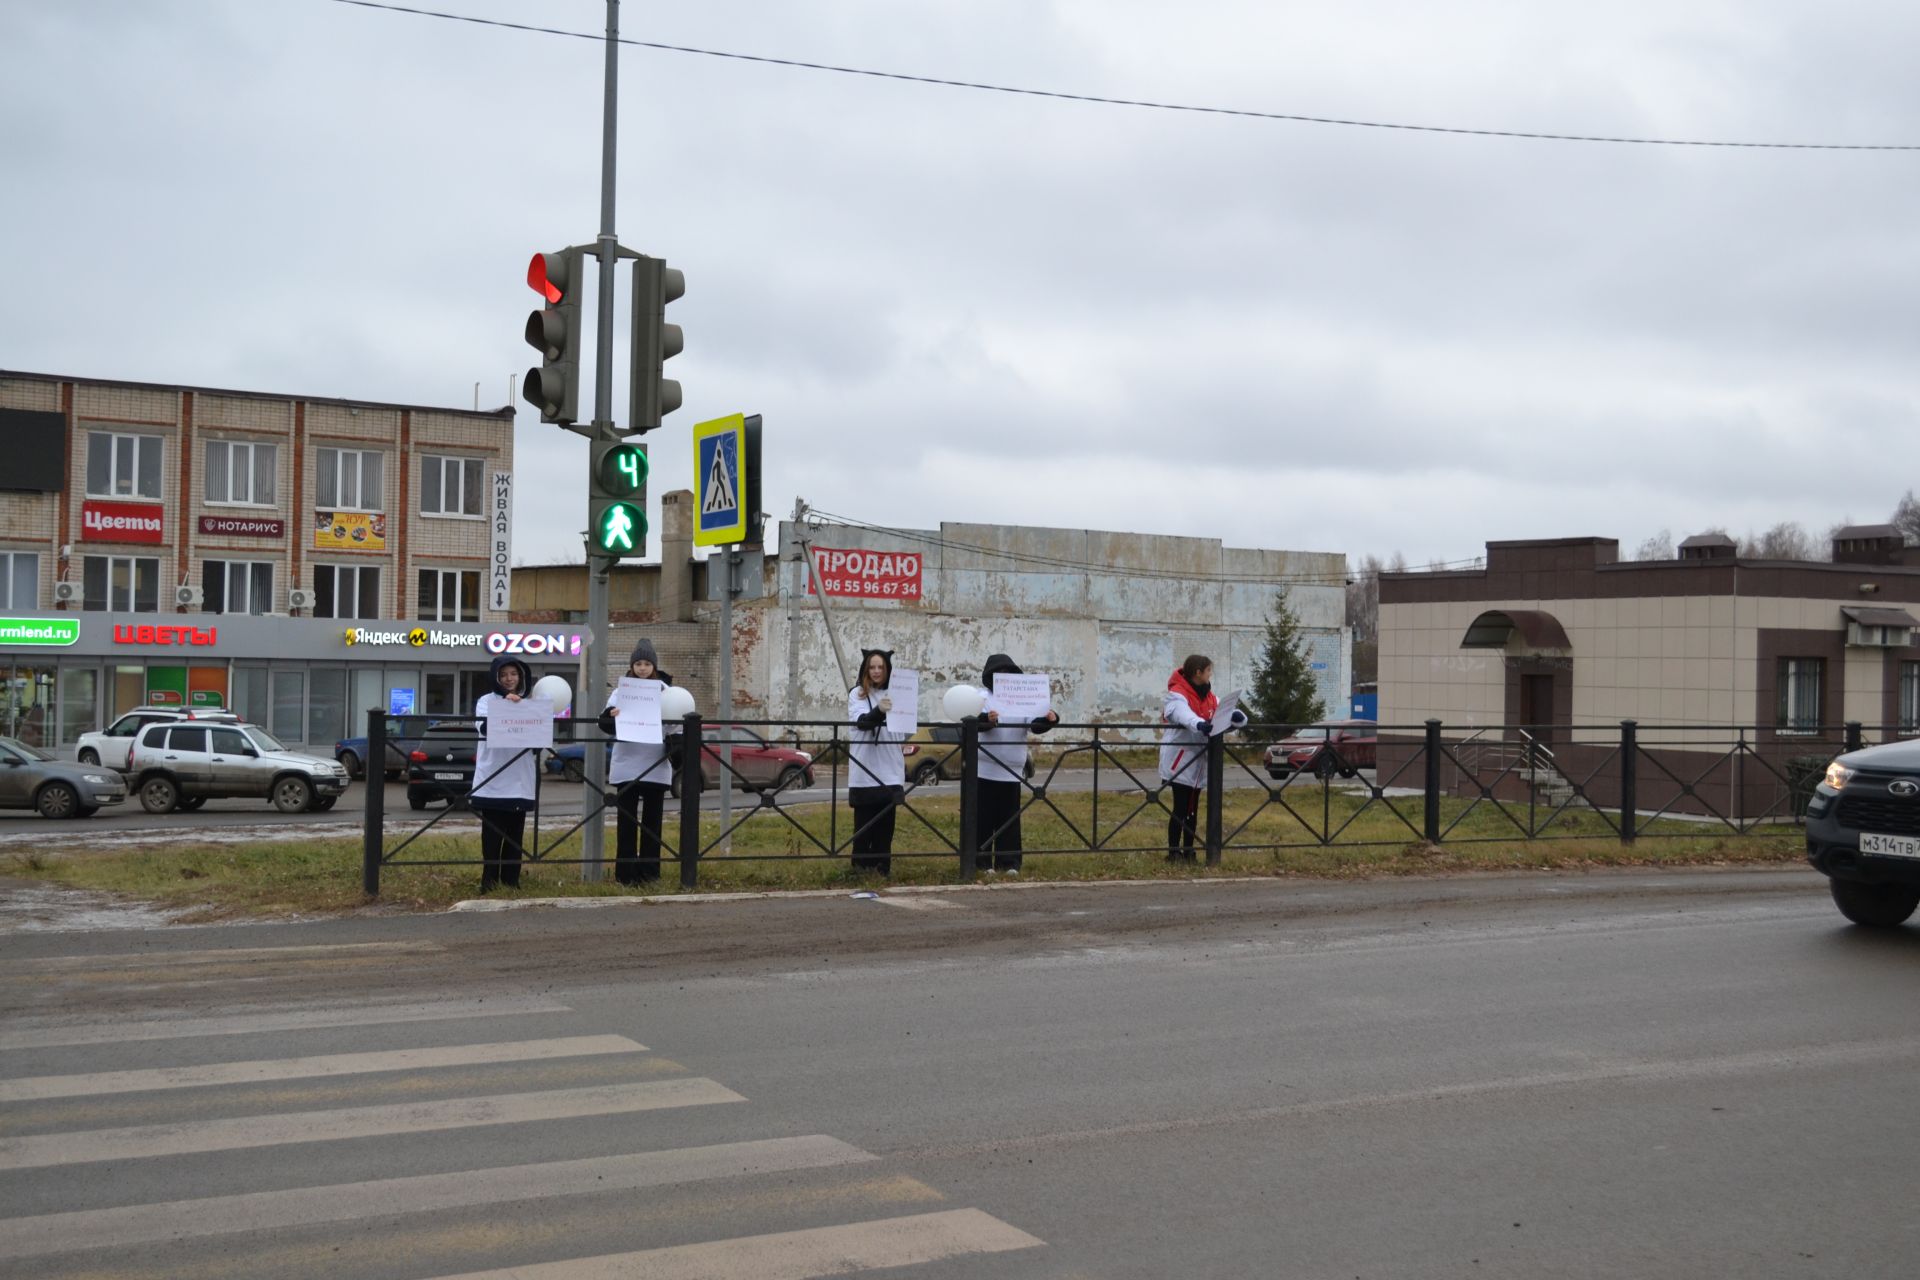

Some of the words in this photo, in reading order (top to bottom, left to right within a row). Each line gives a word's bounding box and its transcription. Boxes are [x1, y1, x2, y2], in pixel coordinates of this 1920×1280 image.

[620, 454, 638, 487] 4
[495, 474, 511, 533] ЖИВАЯ
[84, 510, 162, 532] Цветы
[217, 520, 279, 533] НОТАРИУС
[494, 541, 507, 590] ВОДА
[814, 550, 918, 579] ПРОДАЮ
[825, 579, 841, 592] 96
[844, 579, 860, 593] 55
[864, 581, 879, 594] 96
[883, 583, 898, 595] 67
[902, 583, 917, 596] 34
[113, 624, 217, 646] ЦВЕТЫ
[355, 627, 407, 646] Яндекс
[430, 629, 483, 648] Маркет
[486, 632, 565, 654] OZON
[1863, 836, 1914, 854] М314ТВ
